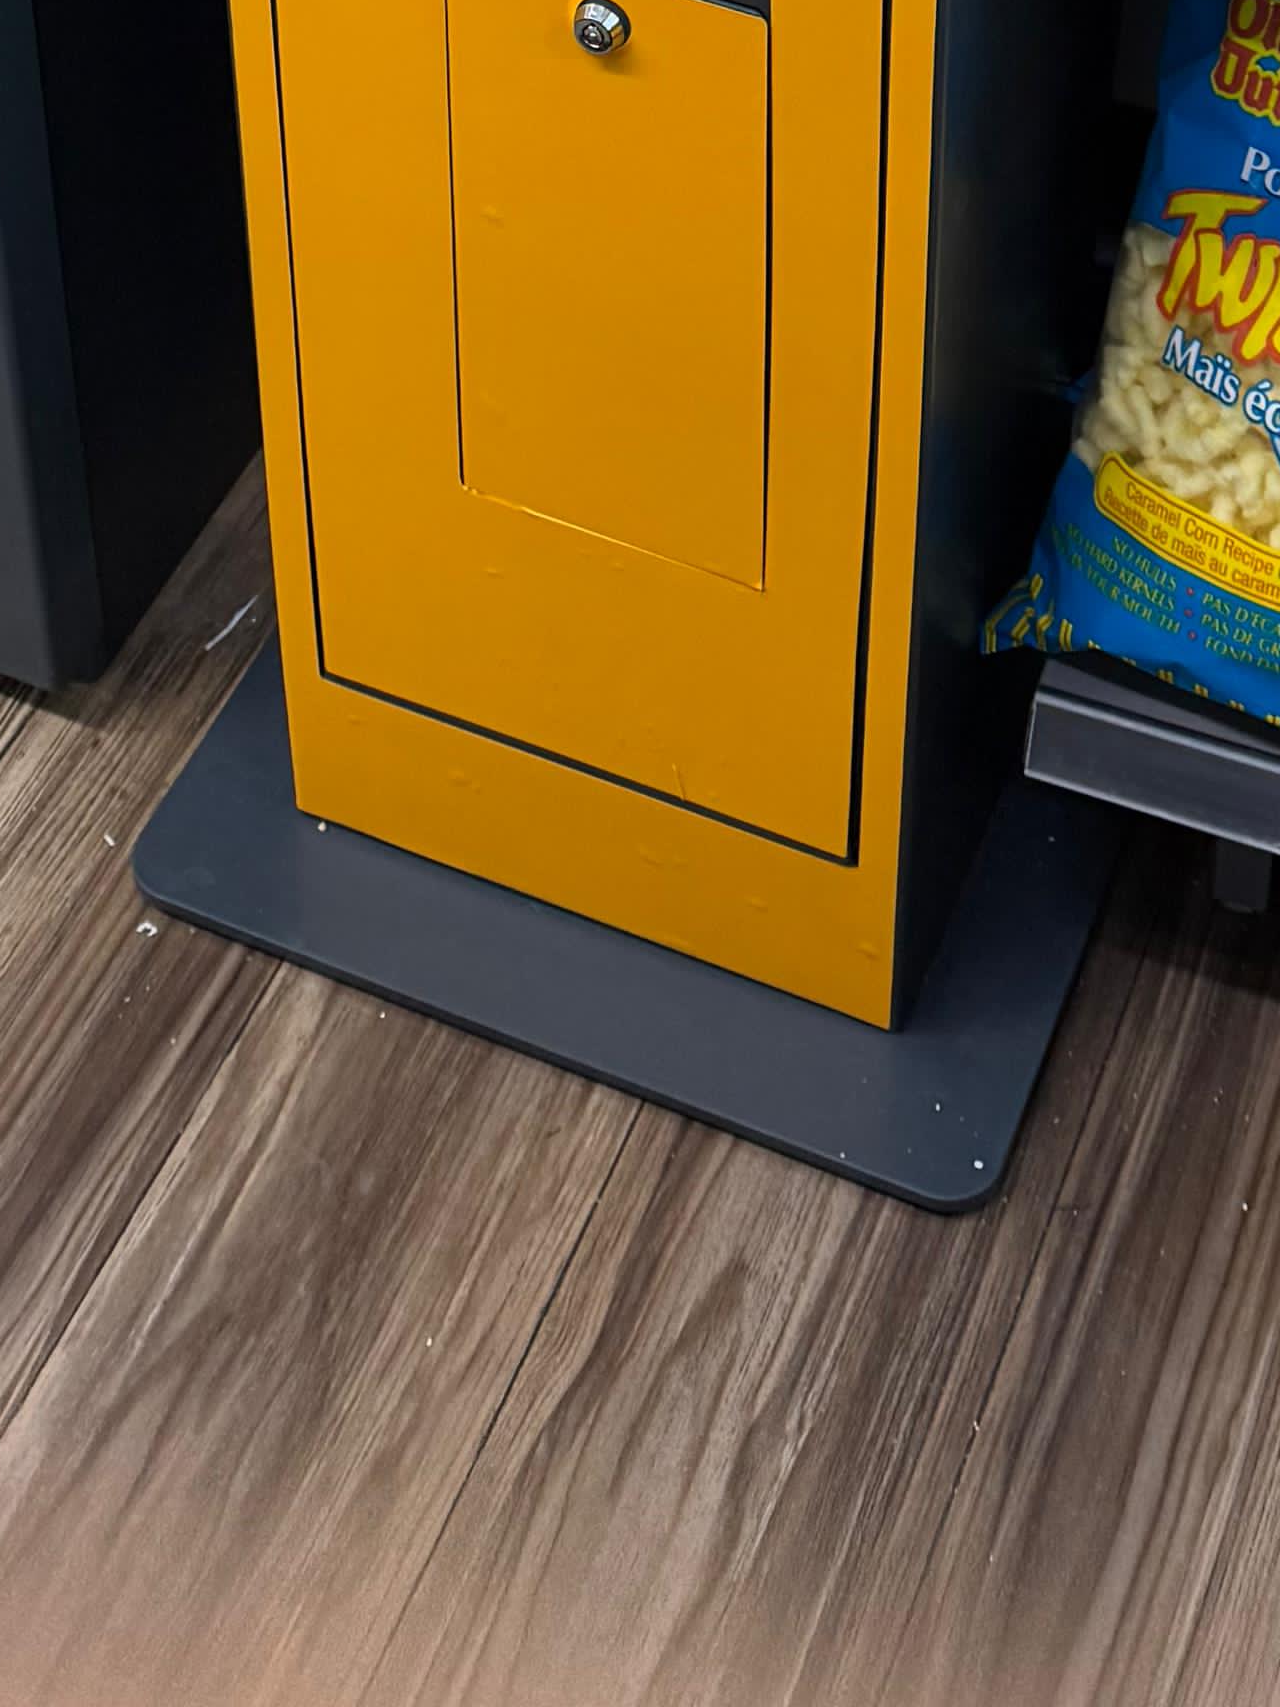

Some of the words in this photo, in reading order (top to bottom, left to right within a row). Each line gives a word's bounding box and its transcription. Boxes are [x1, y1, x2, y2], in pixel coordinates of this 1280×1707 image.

[1162, 326, 1240, 406] Maïs
[1125, 481, 1182, 528] Caramel
[1183, 515, 1219, 549] Corn
[1222, 538, 1275, 577] Recipe
